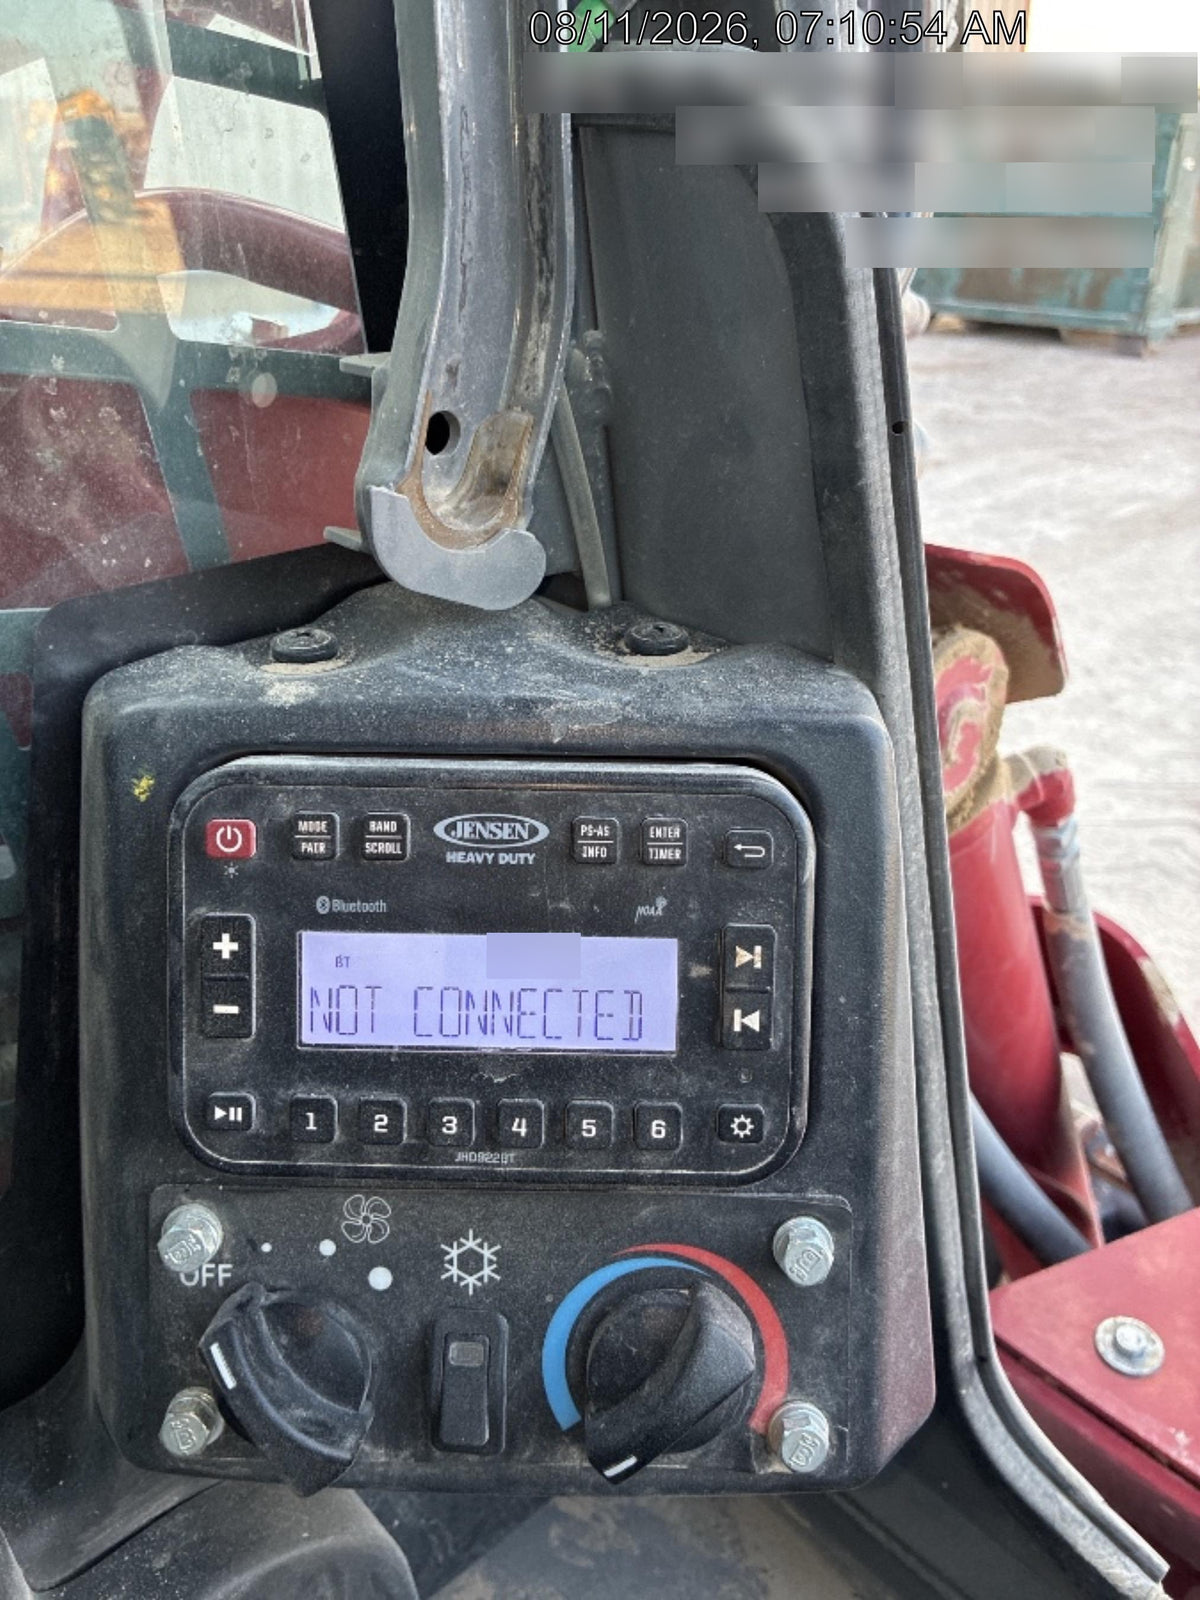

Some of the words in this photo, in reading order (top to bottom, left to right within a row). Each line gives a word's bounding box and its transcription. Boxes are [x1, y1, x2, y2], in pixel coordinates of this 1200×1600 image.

[298, 820, 327, 832] MODE
[369, 820, 397, 833] BAND
[451, 820, 531, 841] JENSEN
[650, 826, 681, 839] ENTER
[301, 842, 326, 854] PAIR
[365, 842, 402, 854] SCROLL
[582, 846, 607, 858] INFO
[648, 847, 681, 860] TIMER
[445, 851, 494, 865] HEAVY
[498, 852, 536, 865] DUTY
[332, 900, 387, 913] Bluetooth
[335, 955, 351, 968] BT
[310, 985, 383, 1035] NOT
[413, 986, 643, 1041] CONNECTED
[305, 1112, 317, 1130] 1
[374, 1114, 389, 1132] 2
[441, 1116, 458, 1134] 3
[511, 1117, 528, 1137] 4
[582, 1119, 597, 1138] 5
[651, 1120, 666, 1139] 6
